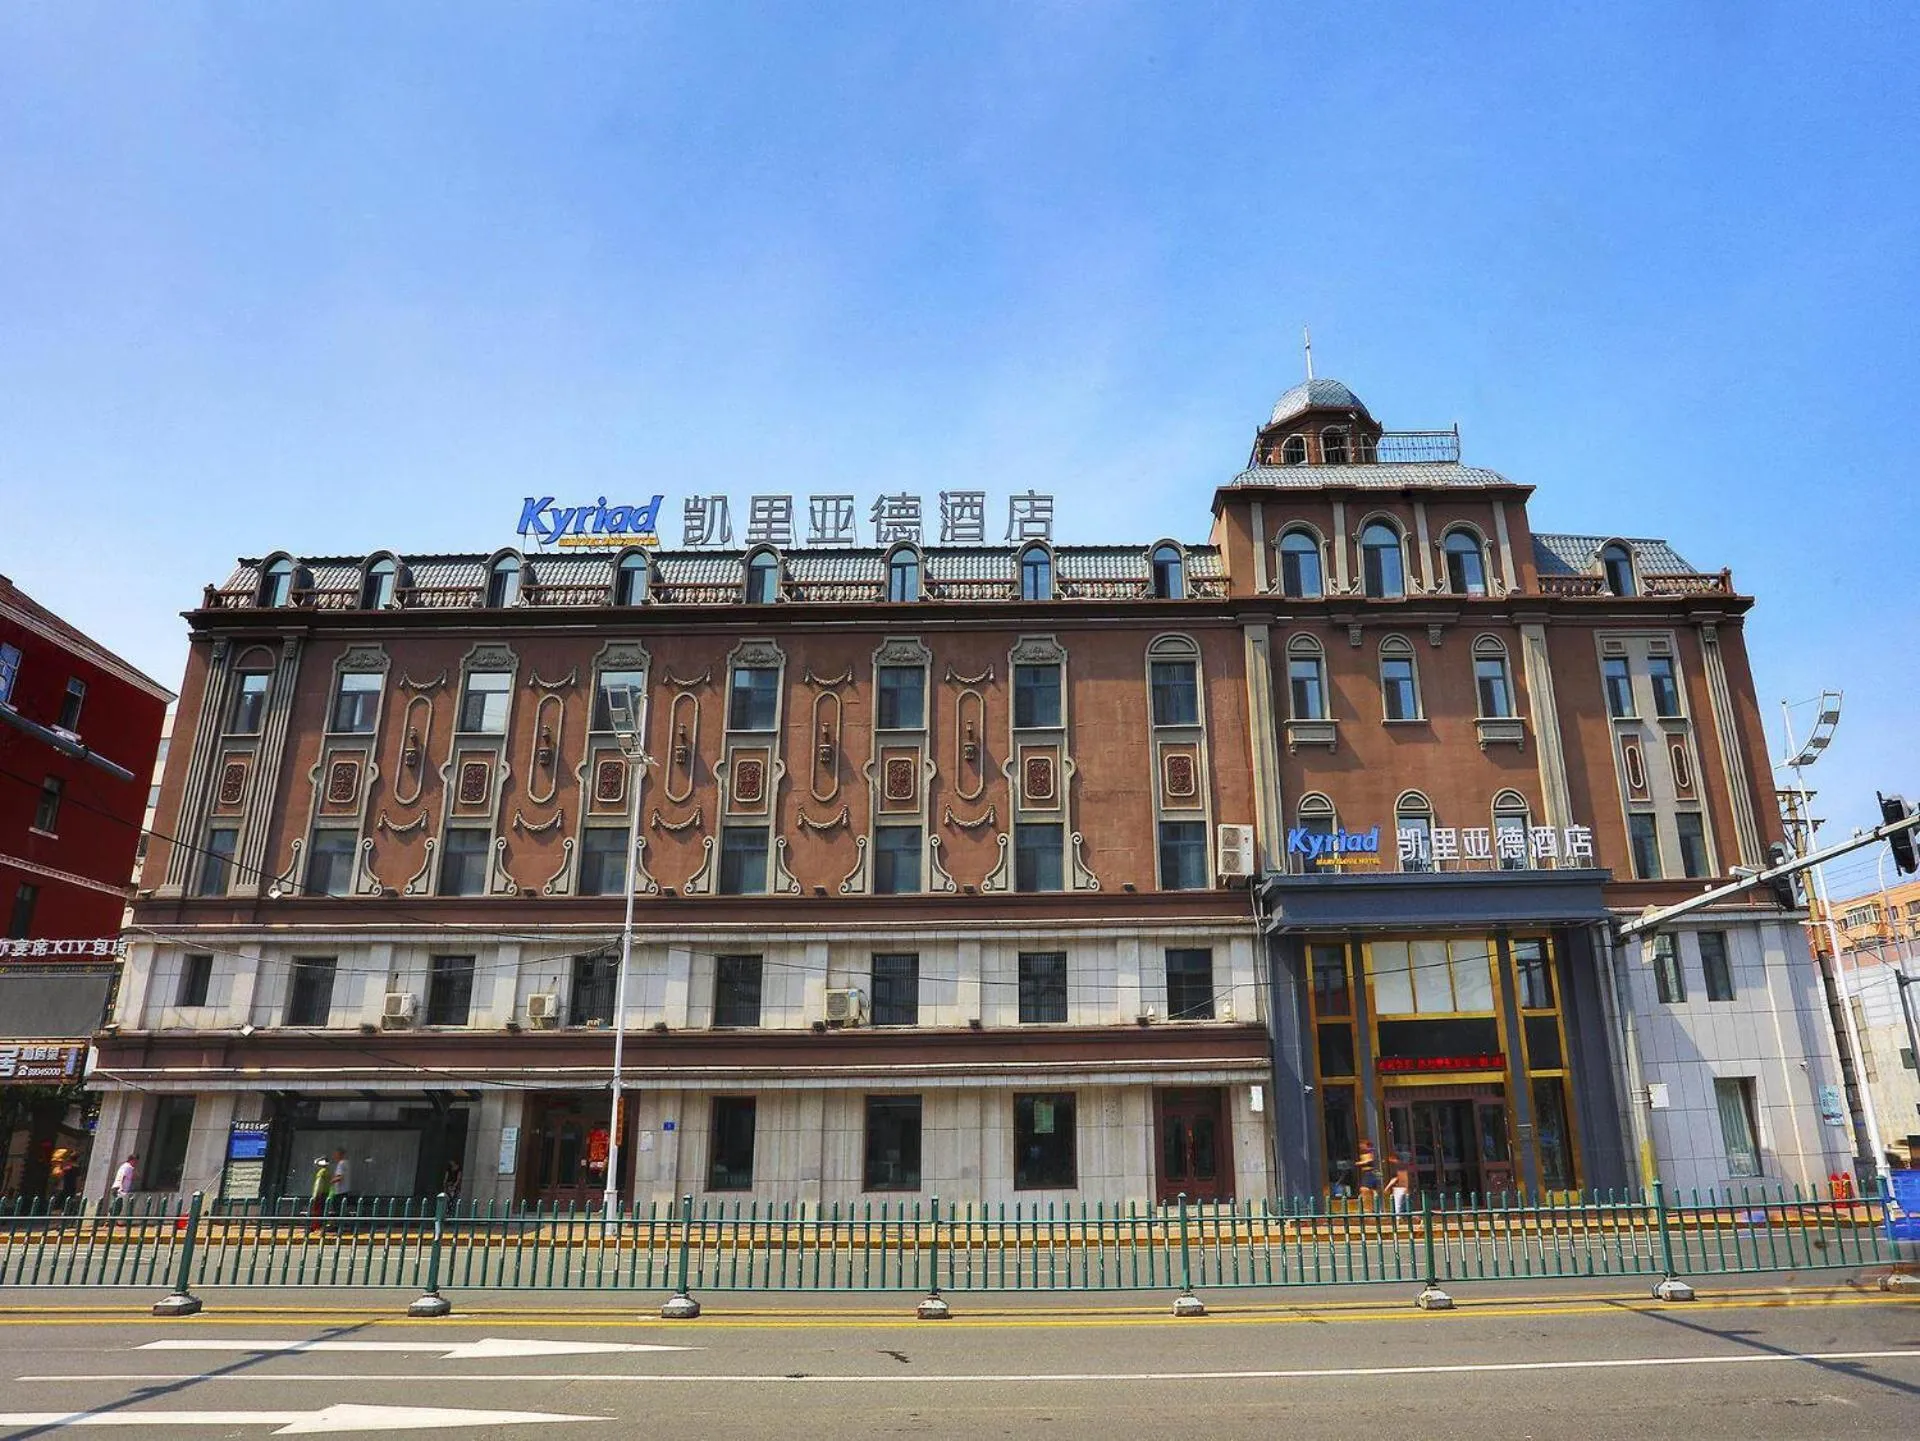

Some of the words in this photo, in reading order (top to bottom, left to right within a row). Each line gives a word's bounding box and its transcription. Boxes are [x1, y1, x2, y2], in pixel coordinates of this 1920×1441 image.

[517, 495, 664, 544] Kyriad
[683, 489, 1054, 545] 凯里亚德酒店
[1288, 824, 1381, 860] Kyriad
[1398, 824, 1593, 861] 凯里亚德酒店
[53, 939, 87, 954] KTV
